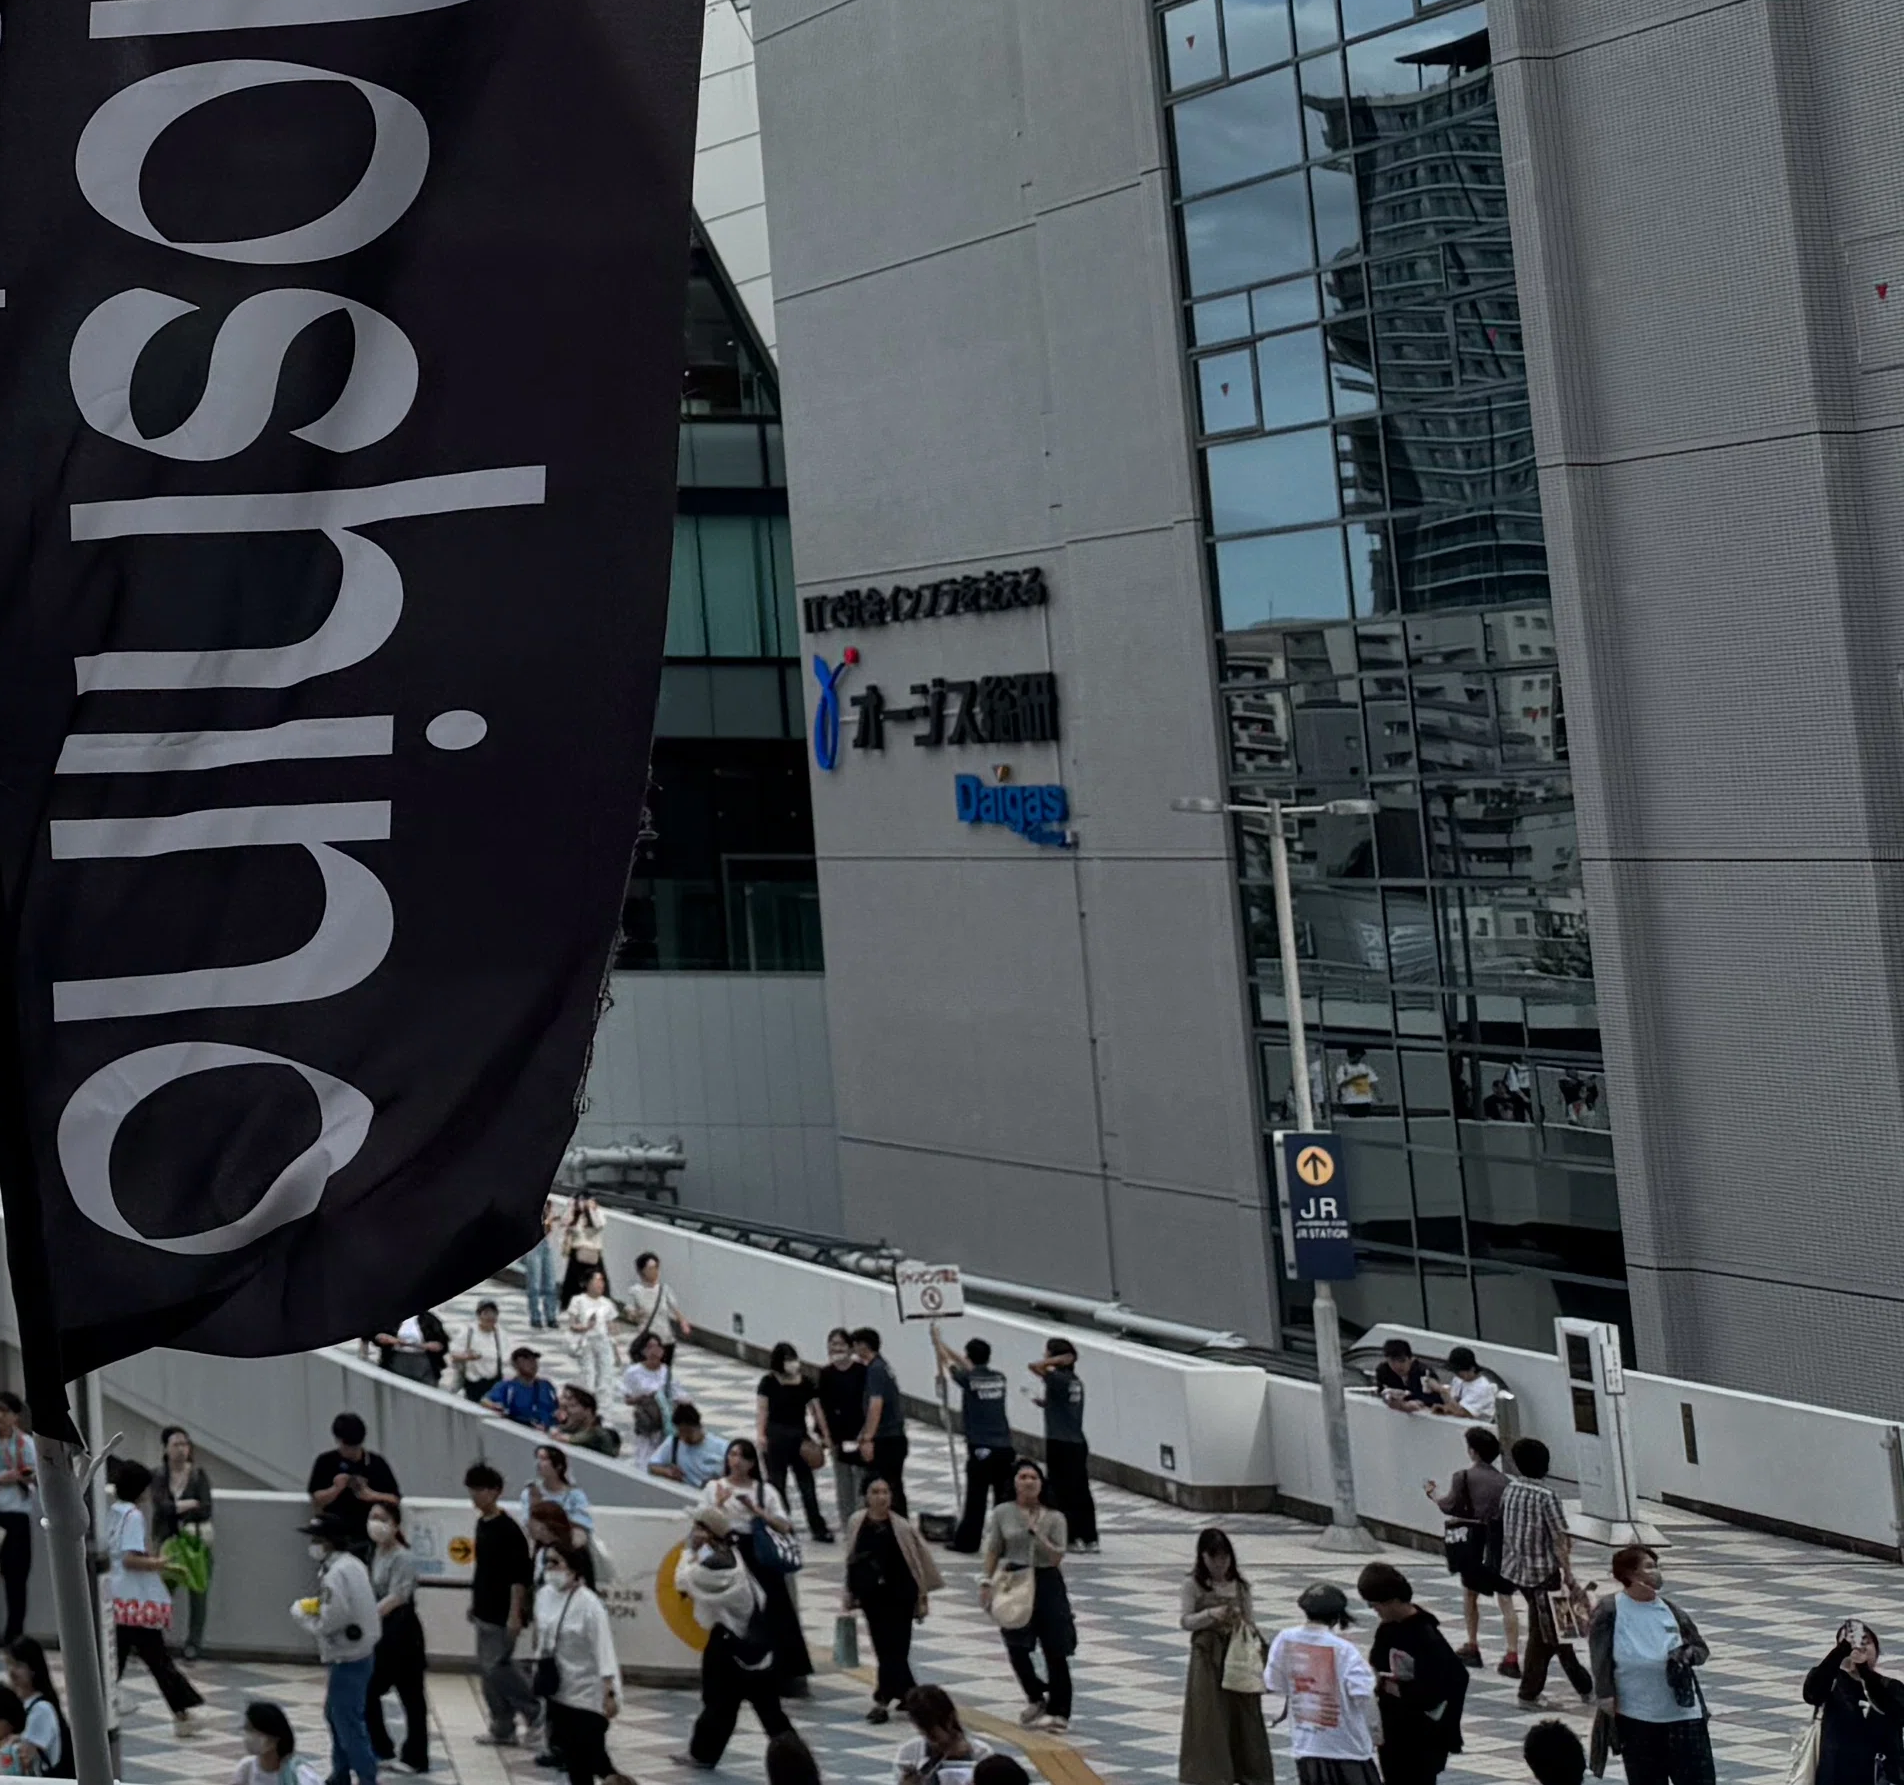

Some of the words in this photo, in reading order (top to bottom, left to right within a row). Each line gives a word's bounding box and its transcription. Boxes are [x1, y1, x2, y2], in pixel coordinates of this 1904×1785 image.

[850, 671, 1060, 750] オージス総研
[955, 765, 1069, 833] Daigas
[1300, 1197, 1338, 1219] JR
[1295, 1229, 1309, 1239] JR
[1310, 1227, 1349, 1239] STATION
